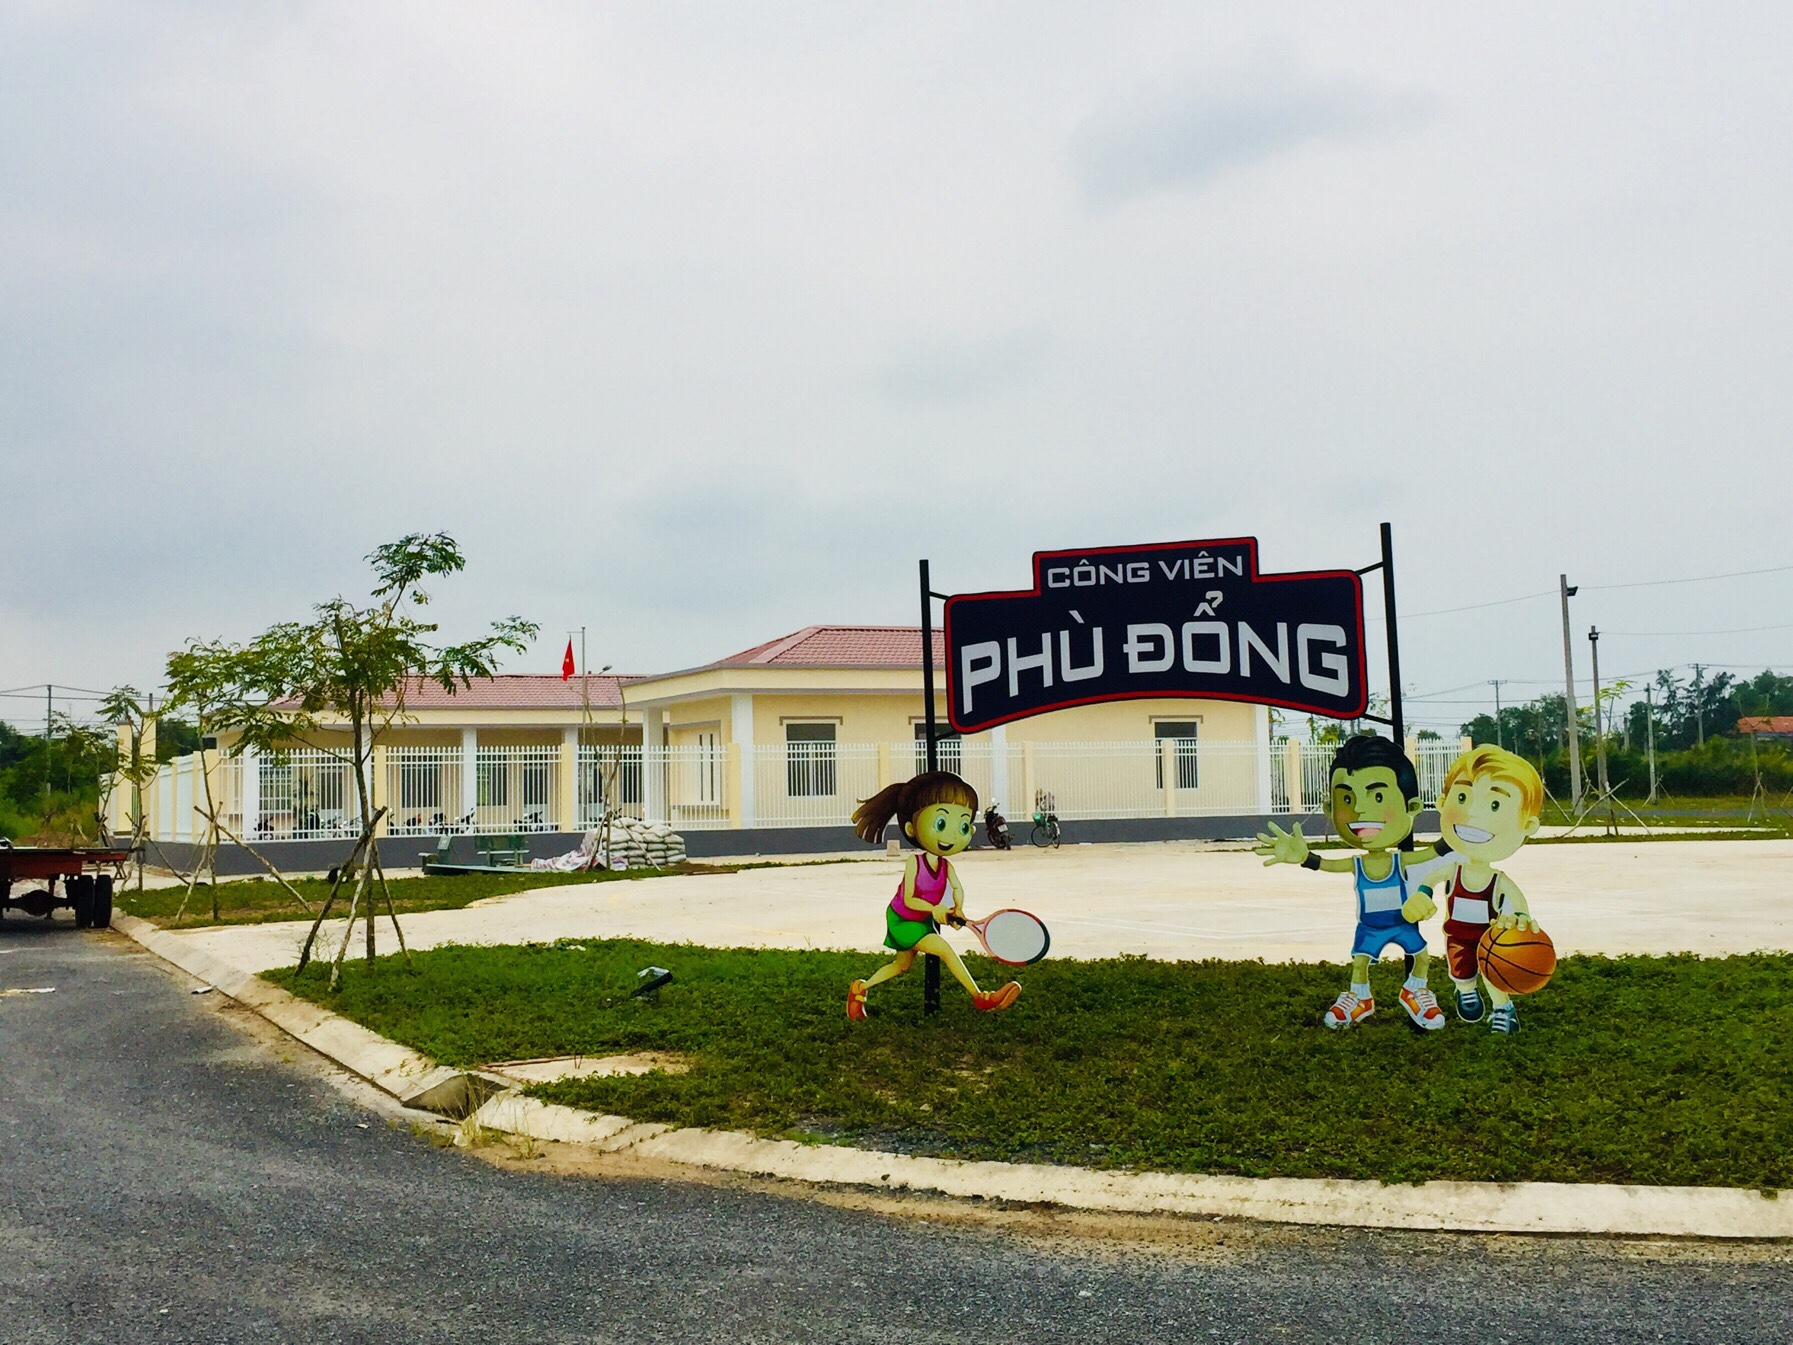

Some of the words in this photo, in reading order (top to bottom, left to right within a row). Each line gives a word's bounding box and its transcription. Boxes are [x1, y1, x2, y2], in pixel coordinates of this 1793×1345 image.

[1047, 558, 1150, 588] CÔNG
[1158, 551, 1244, 580] VIÊN
[961, 610, 1104, 715] PHÙ
[1123, 590, 1349, 698] ĐỔNG
